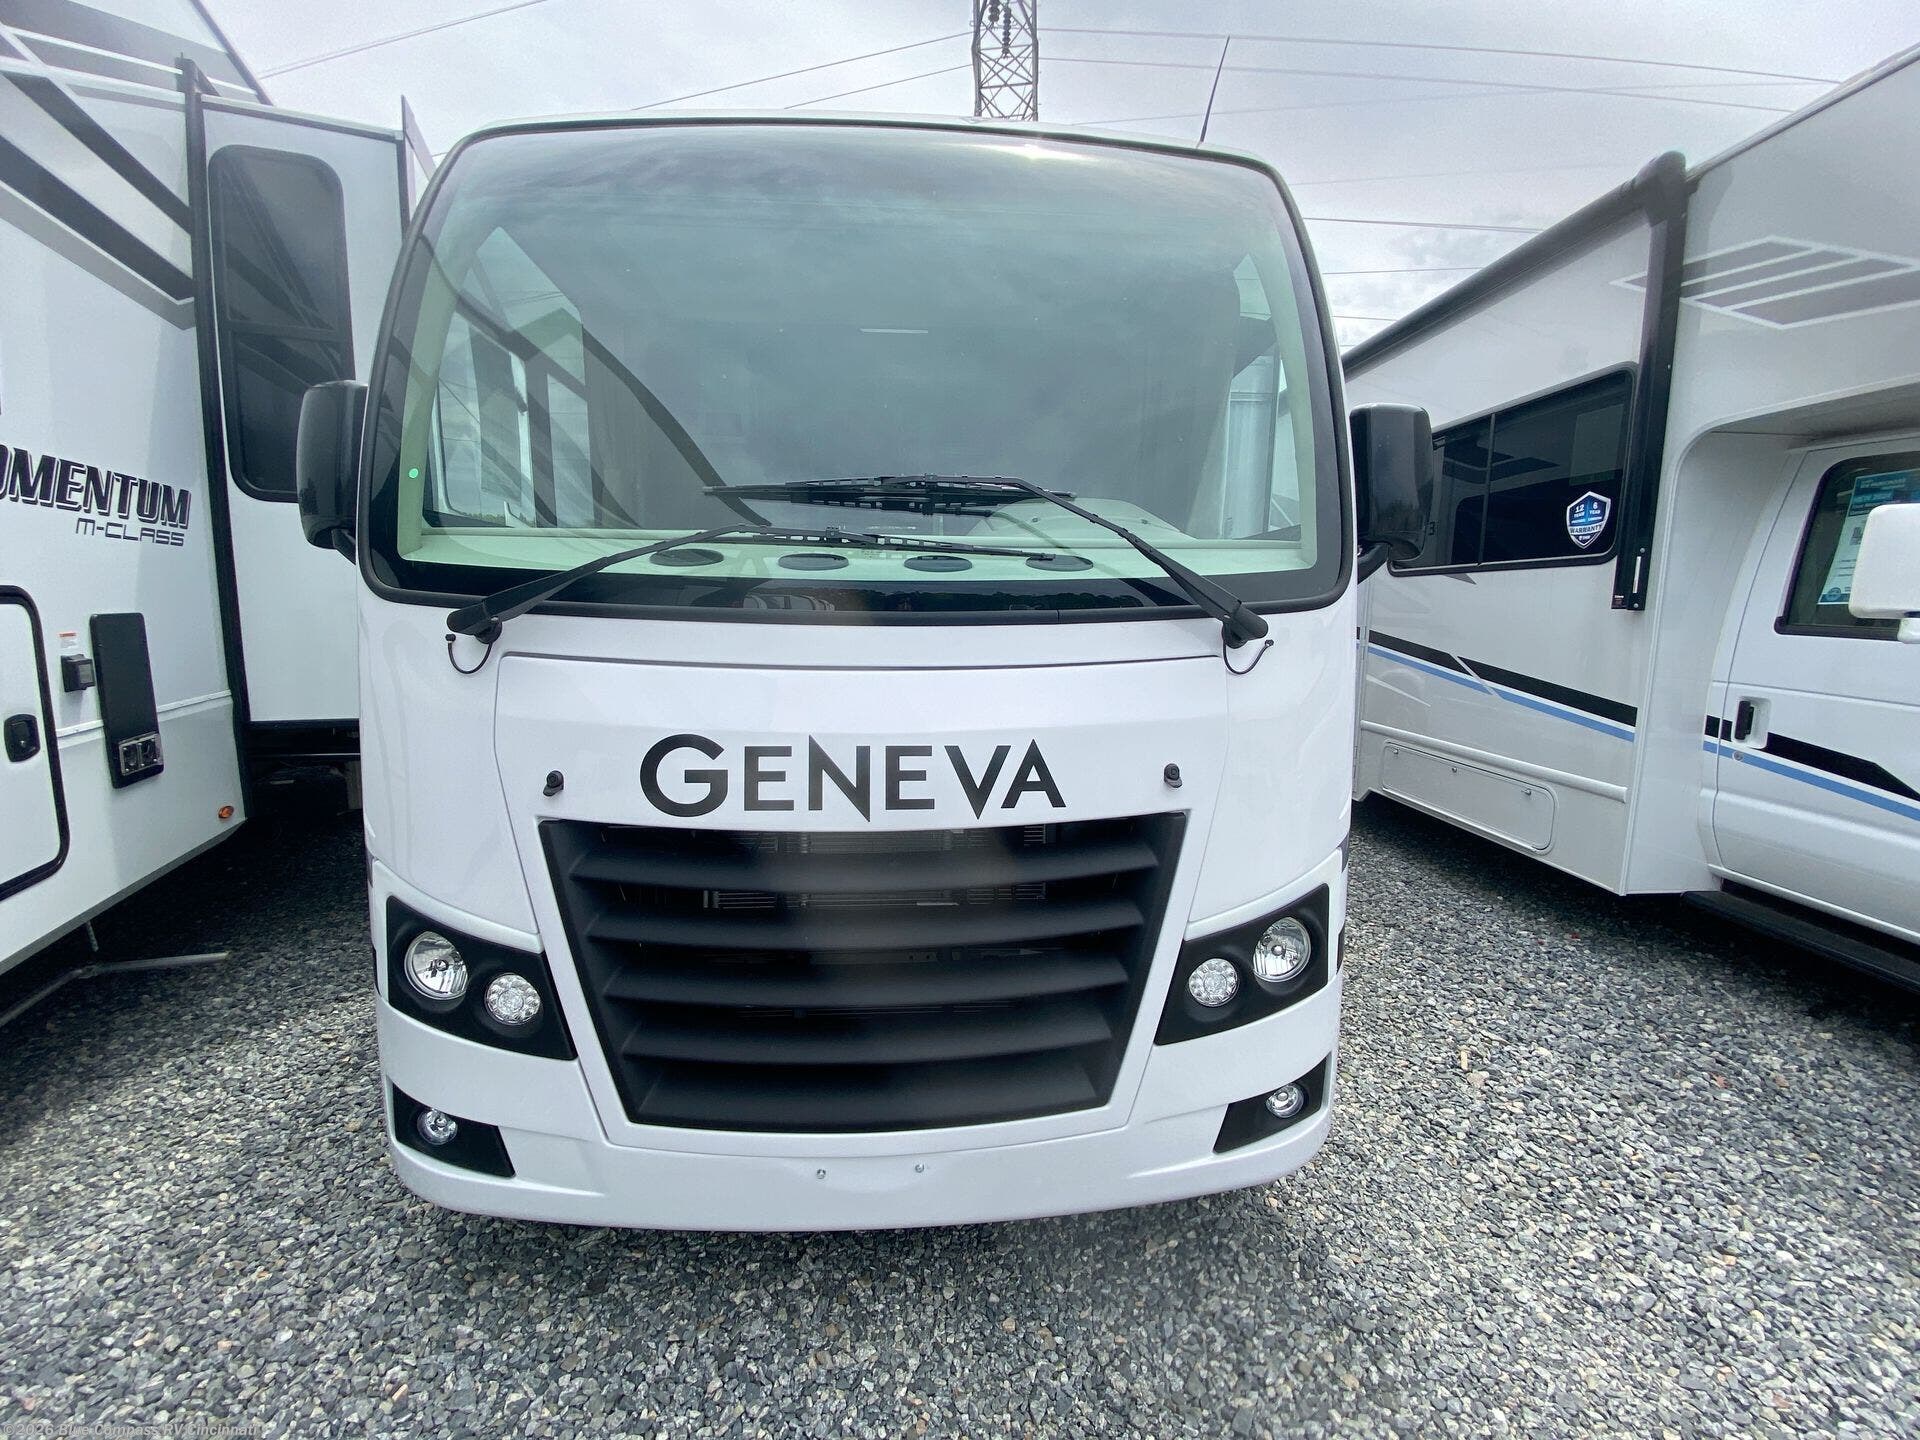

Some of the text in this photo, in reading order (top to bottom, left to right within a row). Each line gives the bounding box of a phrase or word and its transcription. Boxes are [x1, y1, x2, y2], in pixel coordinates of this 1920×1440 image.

[1575, 504, 1585, 513] 12
[1570, 525, 1602, 533] WARRANTY
[640, 734, 1066, 822] GENEVA
